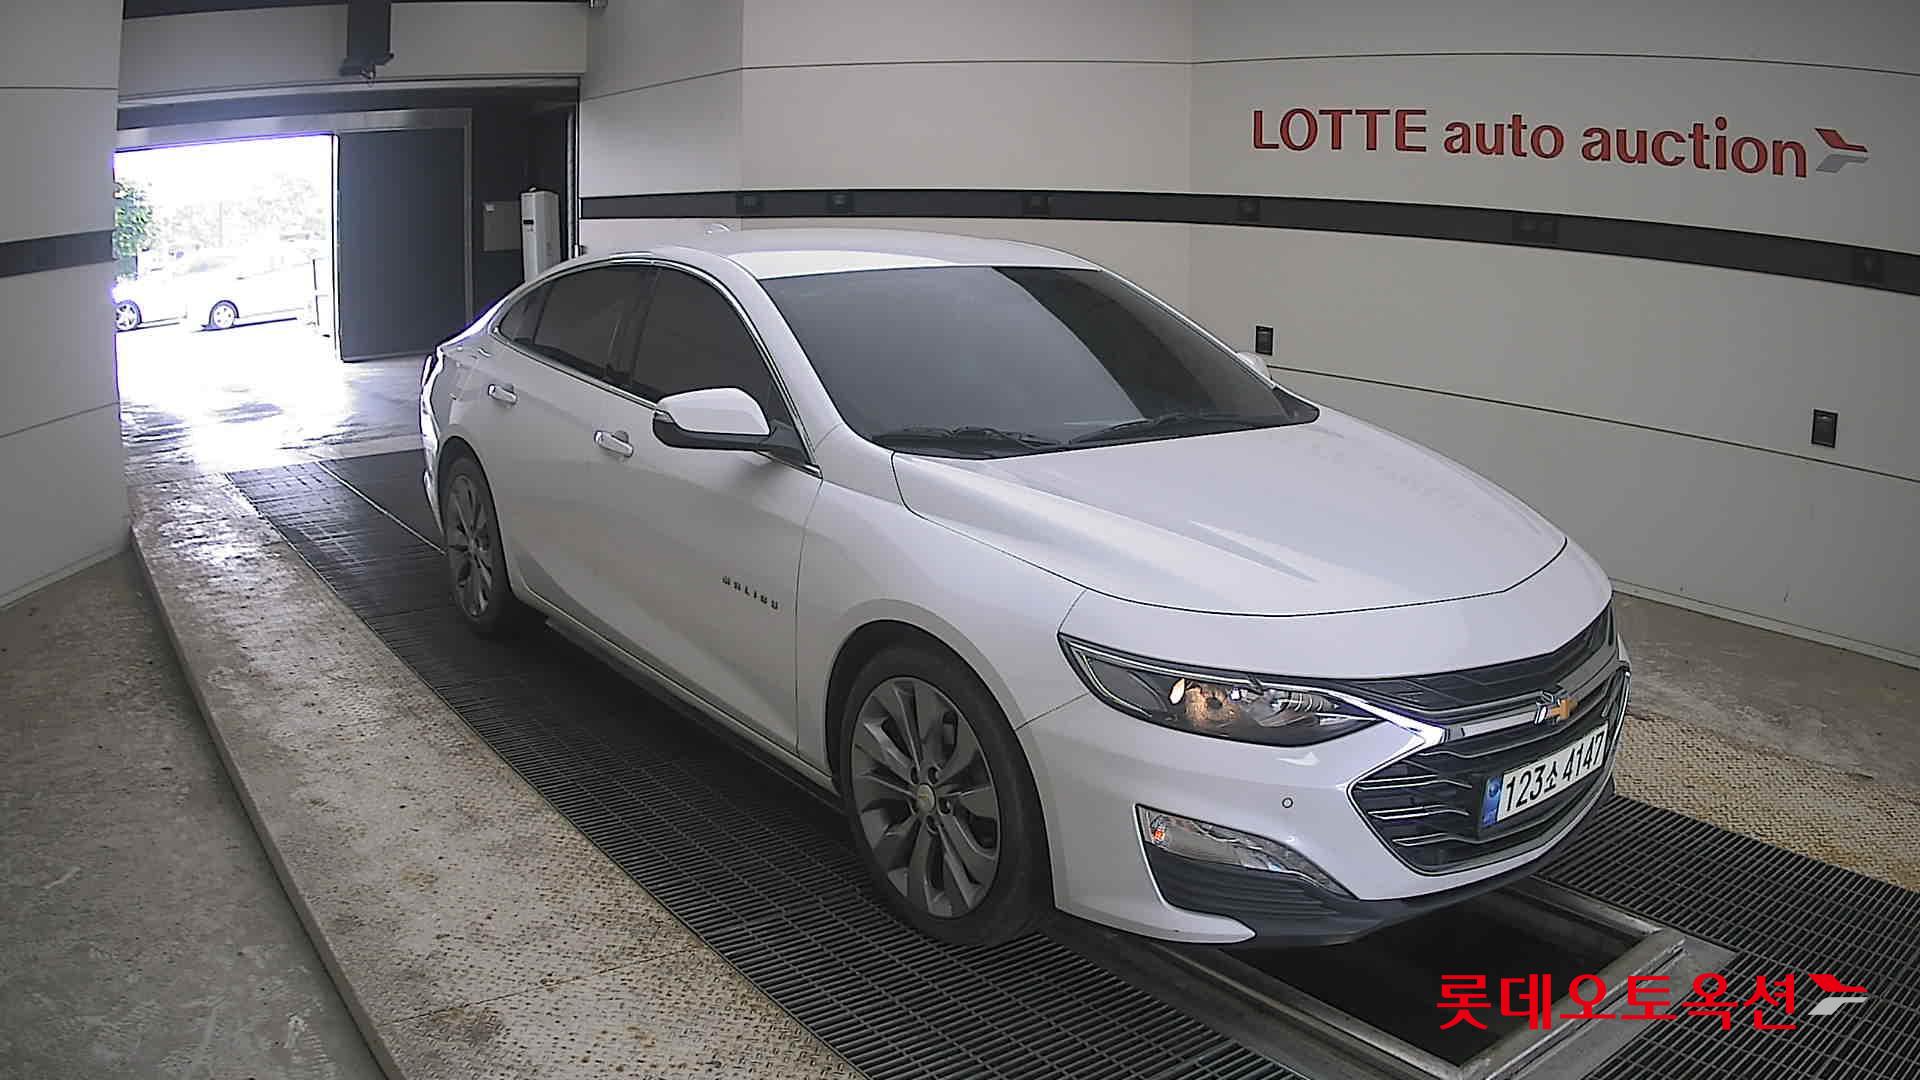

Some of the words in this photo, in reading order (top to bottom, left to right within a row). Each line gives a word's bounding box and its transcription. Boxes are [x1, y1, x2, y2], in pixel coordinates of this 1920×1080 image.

[1252, 108, 1427, 153] LOTTE
[1443, 113, 1565, 159] auto
[1581, 116, 1808, 179] auction
